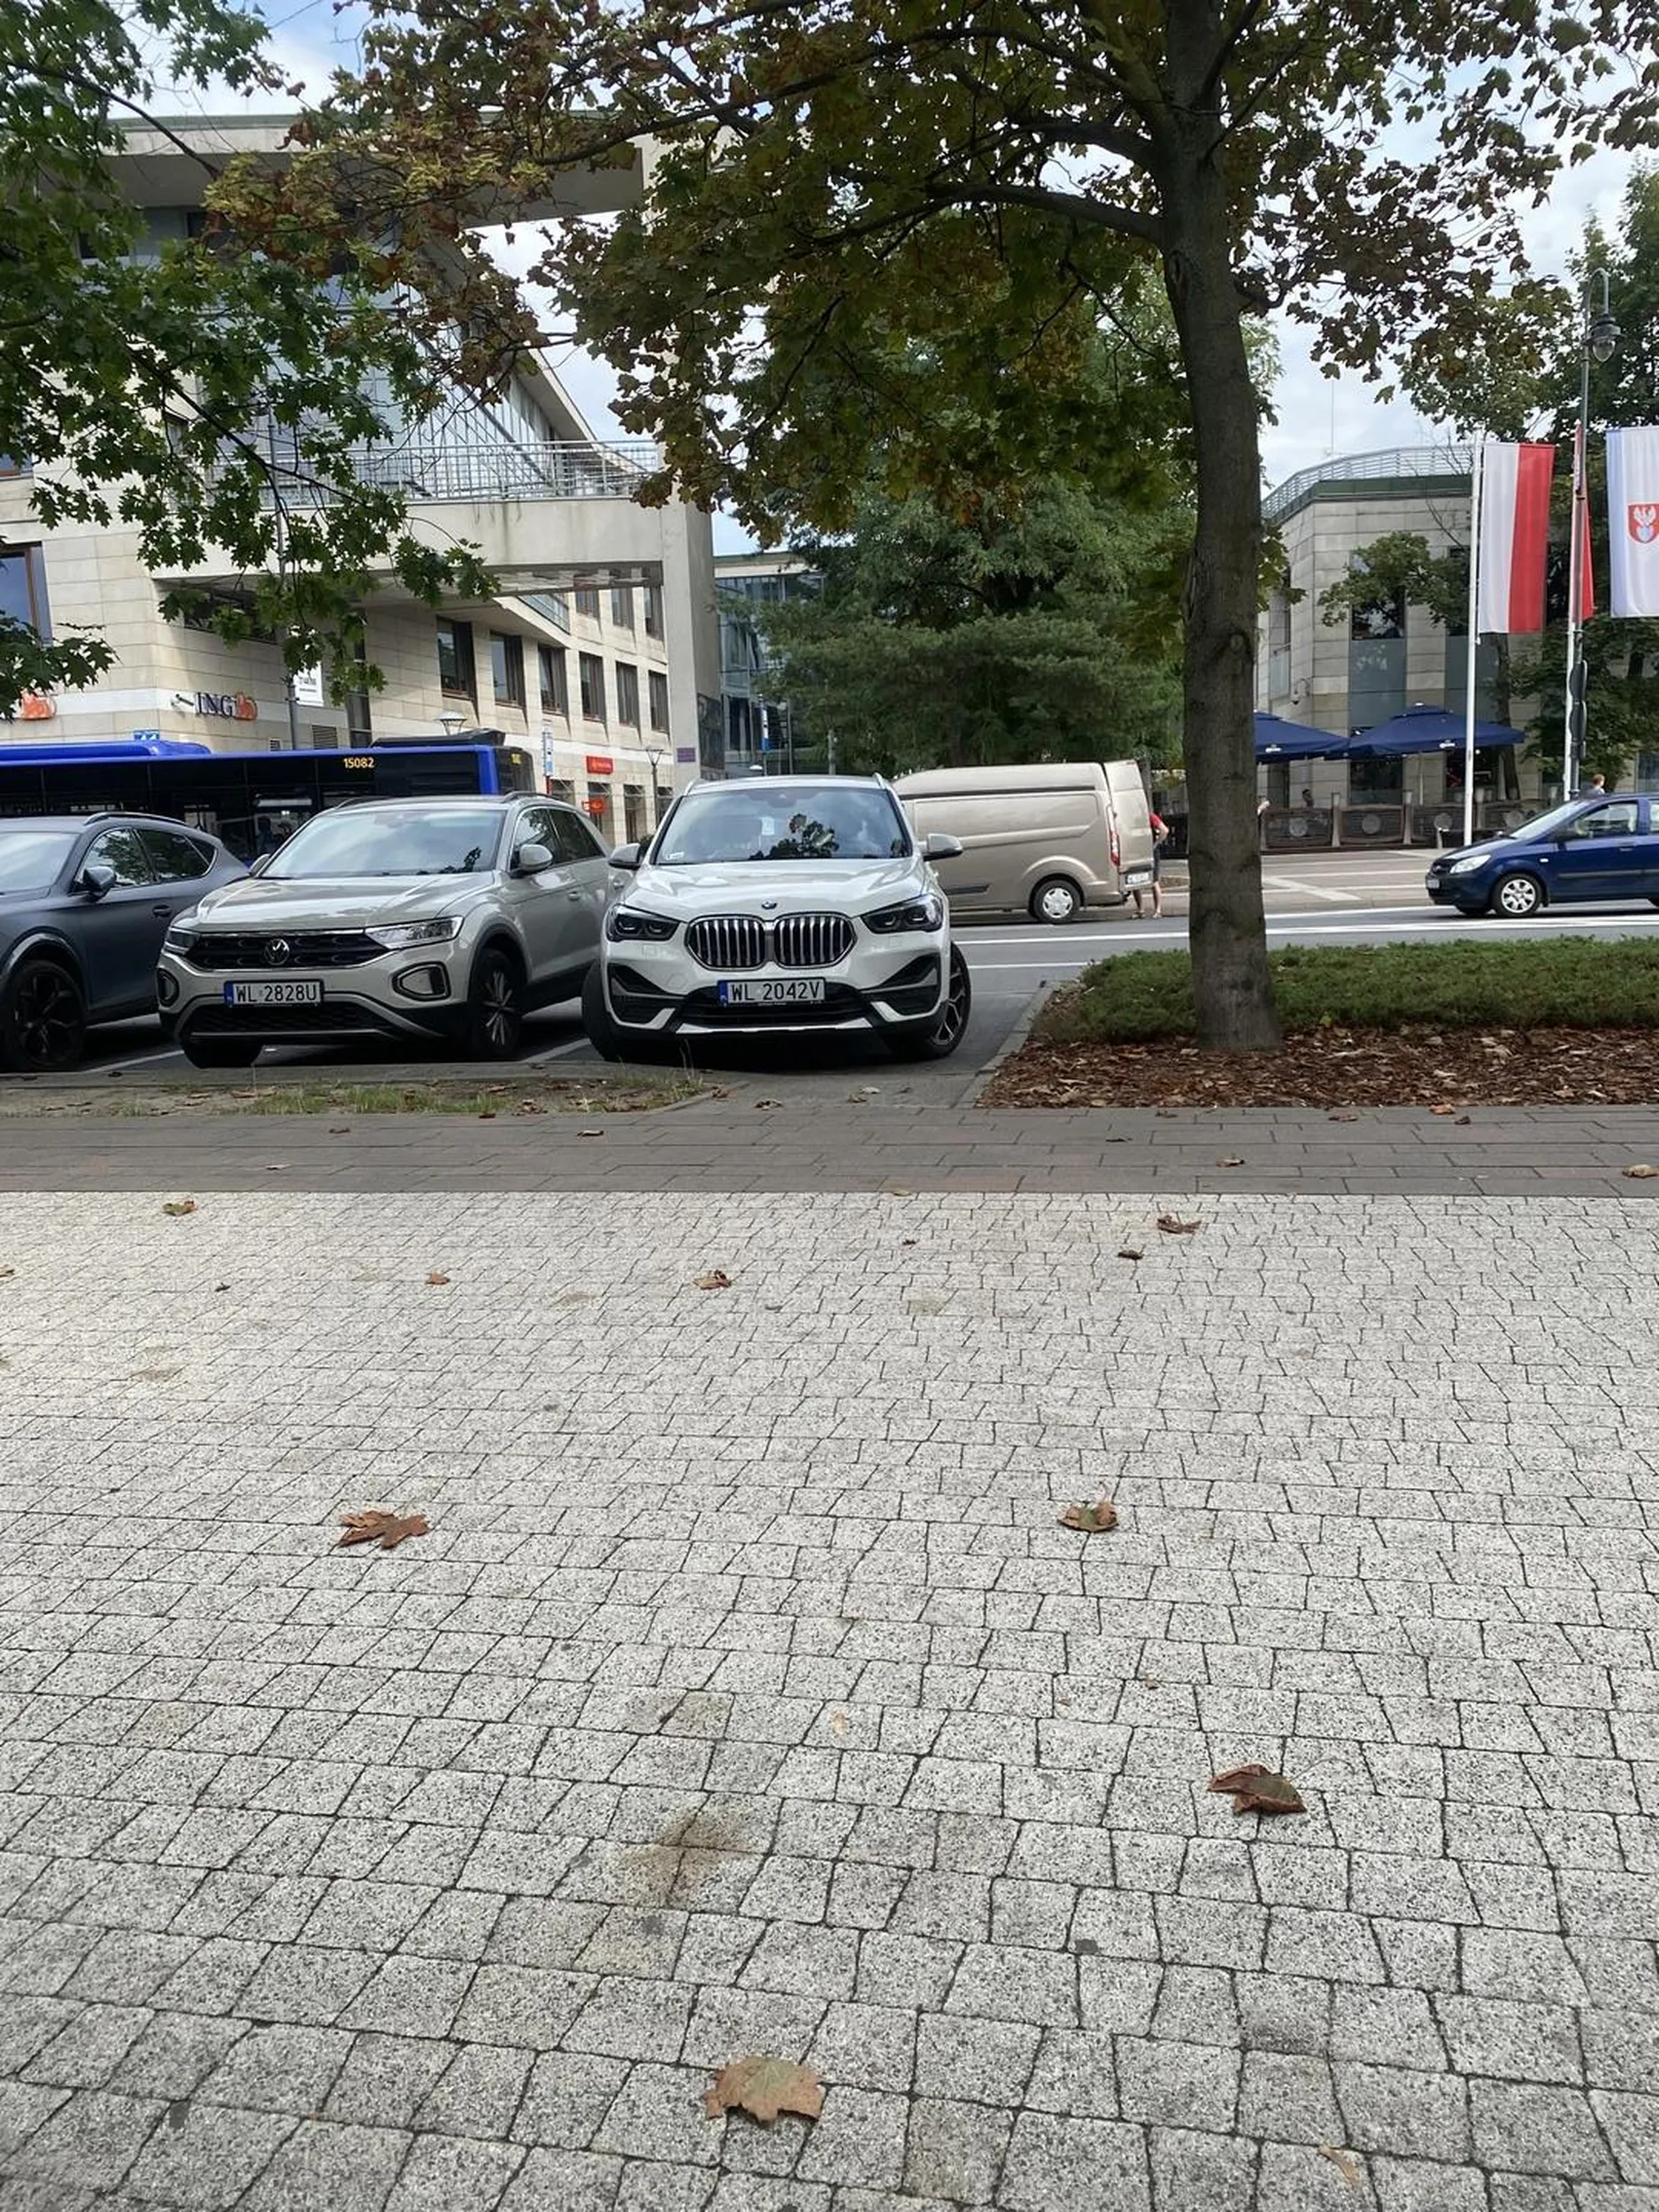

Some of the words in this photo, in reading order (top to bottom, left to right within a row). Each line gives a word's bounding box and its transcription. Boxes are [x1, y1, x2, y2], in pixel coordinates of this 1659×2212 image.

[196, 692, 236, 718] ING
[343, 757, 375, 769] 15082
[235, 985, 257, 1002] WL
[265, 984, 317, 1002] 2828U
[732, 984, 755, 1002] WL
[763, 981, 820, 1001] 2042V
